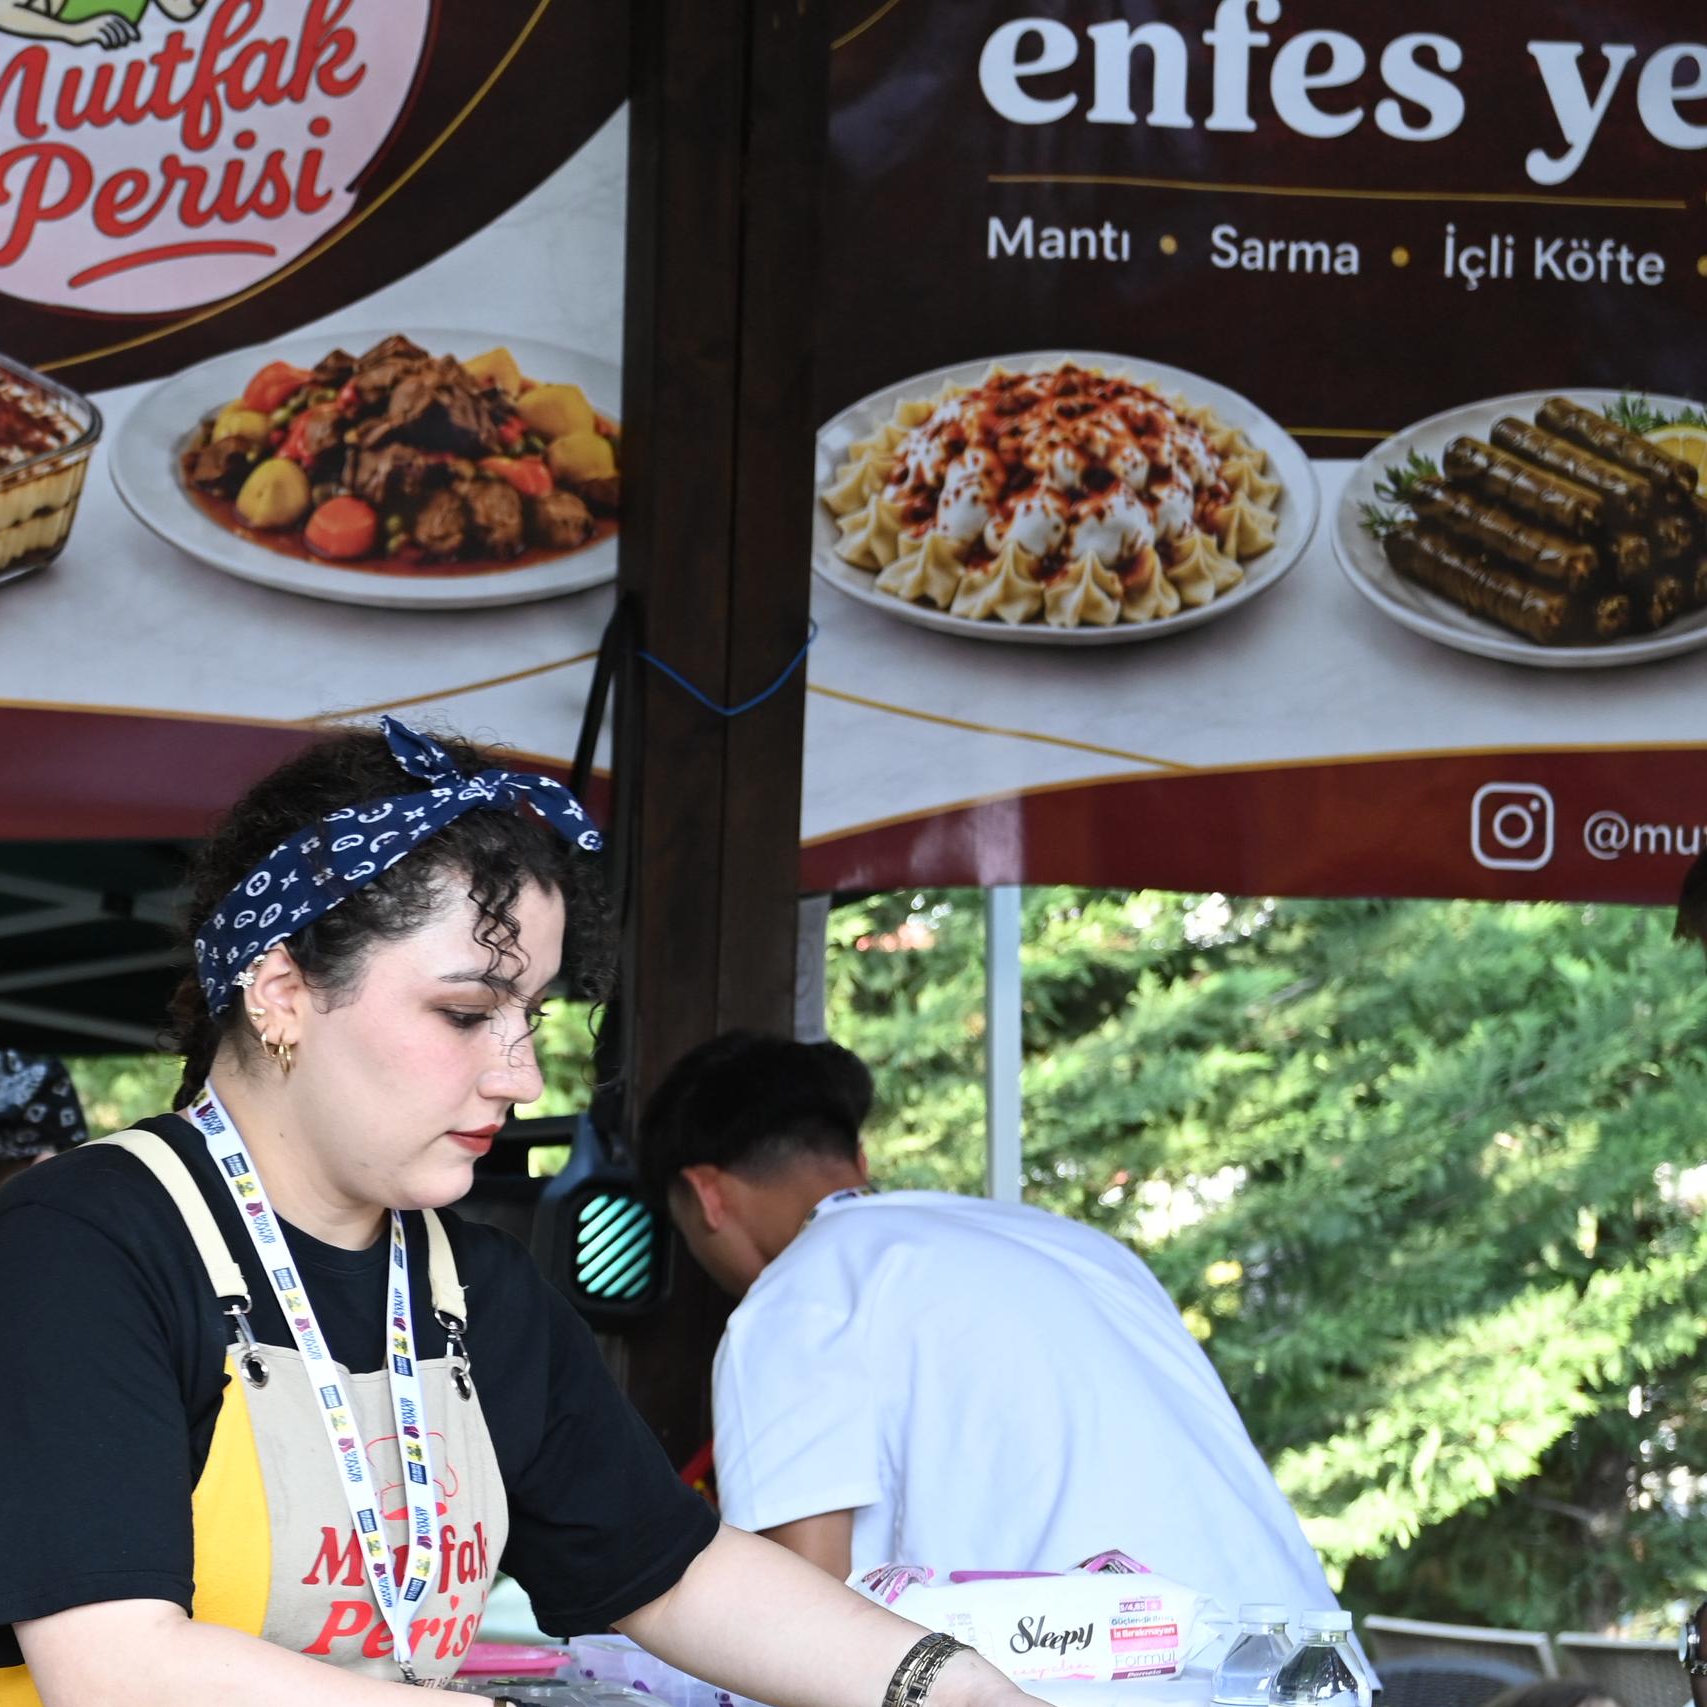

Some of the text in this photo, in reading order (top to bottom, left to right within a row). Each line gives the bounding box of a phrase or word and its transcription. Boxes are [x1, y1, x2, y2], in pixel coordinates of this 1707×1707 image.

[978, 0, 1465, 141] enfes
[988, 217, 1665, 291] Mantı Sarma İçli Köfte
[1584, 811, 1707, 861] @mu
[301, 1522, 489, 1594] Mfak
[300, 1594, 483, 1661] Peris
[1009, 1615, 1094, 1656] Sleepy
